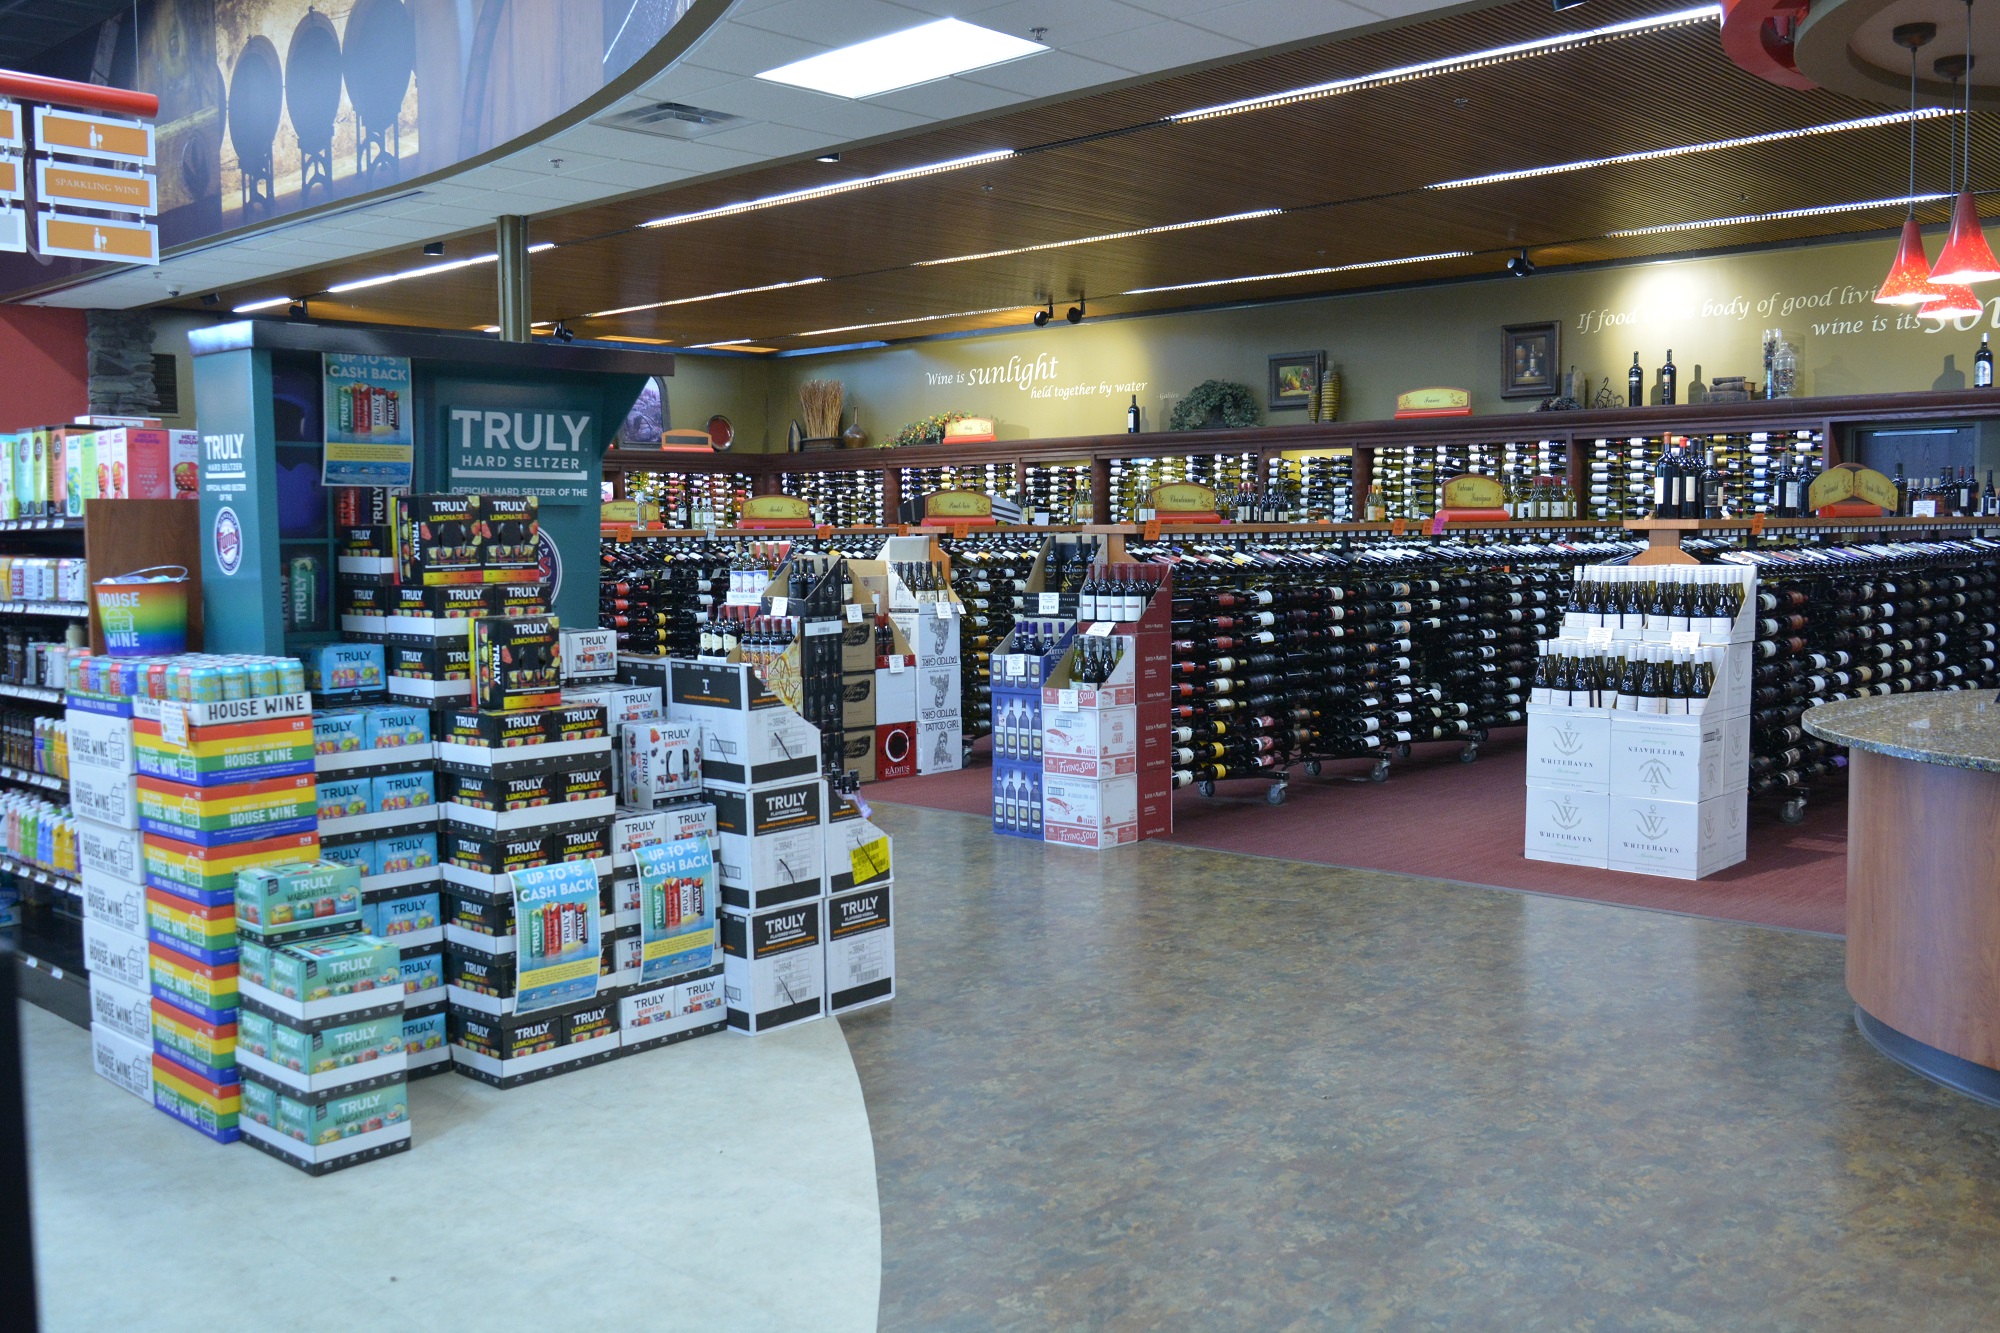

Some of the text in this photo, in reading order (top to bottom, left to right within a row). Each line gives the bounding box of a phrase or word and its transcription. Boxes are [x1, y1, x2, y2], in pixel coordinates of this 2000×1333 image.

[55, 178, 141, 196] SPARKLING WINE
[1577, 310, 1596, 335] If
[1593, 306, 1639, 333] food
[1701, 295, 1750, 320] body
[1757, 292, 1781, 318] of
[1781, 287, 1838, 317] good
[1811, 317, 1863, 336] wine
[1872, 314, 1888, 332] is
[1896, 313, 1922, 330] its
[329, 365, 406, 381] CASH BACK
[925, 352, 1059, 391] Wine is sunlight
[1031, 380, 1148, 401] held together by water
[341, 396, 349, 427] TRULY
[452, 409, 590, 452] TRULY
[203, 433, 244, 461] TRULY
[208, 462, 243, 472] HARD SELTZER
[462, 455, 580, 469] HARD SELTZER
[451, 486, 588, 497] OFFICIAL HARD SELTZER OF THE
[432, 501, 468, 512] TRULY
[493, 501, 527, 512] TRULY
[429, 513, 465, 522] LEMONADE
[490, 513, 524, 522] LEMONADE
[351, 530, 371, 540] TRULY
[413, 521, 421, 561] TRULY
[295, 574, 307, 623] TRULY
[401, 590, 423, 600] TRULY
[447, 589, 483, 600] TRULY
[507, 586, 540, 598] TRULY
[98, 591, 141, 608] HOUSE
[445, 600, 479, 609] LEMONADE
[504, 597, 537, 606] LEMONADE
[514, 623, 549, 635] TRULY
[107, 632, 140, 648] WINE
[511, 636, 545, 645] LEMONADE
[579, 635, 608, 646] TRULY
[336, 650, 371, 662] TRULY
[401, 650, 423, 662] TRULY
[922, 656, 958, 666] TATTOO GIRL
[623, 692, 652, 704] TRULY
[1078, 691, 1095, 704] SOLO
[208, 695, 305, 720] HOUSE WINE
[627, 703, 642, 712] BERRY
[922, 708, 958, 719] TATTOO GIRL
[380, 715, 416, 729] TRULY
[455, 715, 479, 728] TRULY
[505, 715, 541, 728] TRULY
[564, 709, 599, 722] TRULY
[314, 721, 352, 734] TRULY
[561, 719, 594, 731] LEMONADE
[925, 720, 960, 732] TATTOO GIRL
[661, 728, 691, 740] TRULY
[72, 735, 109, 758] HOUSE WINE
[664, 740, 681, 748] BERRY
[224, 748, 293, 768] HOUSE WINE
[1628, 746, 1685, 757] WHITEHAVEN
[1058, 760, 1096, 773] FLYING SOLO
[1540, 757, 1593, 768] WHITEHAVEN
[569, 770, 601, 783] TRULY
[885, 765, 910, 775] RADIUS
[387, 776, 423, 790] TRULY
[508, 778, 544, 792] TRULY
[76, 787, 110, 811] HOUSE WINE
[766, 791, 808, 811] TRULY
[229, 804, 298, 827] HOUSE WINE
[625, 820, 655, 833] TRULY
[1060, 828, 1097, 843] FLYING SOLO
[1539, 831, 1593, 843] WHITEHAVEN
[84, 839, 118, 865] HOUSE WINE
[506, 840, 542, 855] TRULY
[648, 841, 699, 861] UP TO $5
[1622, 841, 1680, 854] WHITEHAVEN
[643, 854, 710, 879] CASH BACK
[526, 865, 583, 885] UP TO $5
[290, 875, 334, 891] TRULY
[287, 888, 327, 902] MARGARITA
[520, 878, 595, 903] CASH BACK
[392, 900, 427, 915] TRULY
[841, 896, 878, 916] TRULY
[765, 912, 806, 934] TRULY
[532, 920, 541, 953] TRULY
[330, 956, 373, 974] TRULY
[686, 981, 716, 997] TRULY
[634, 993, 665, 1009] TRULY
[689, 993, 707, 1004] BERRY
[515, 1023, 550, 1040] TRULY
[338, 1094, 381, 1115] TRULY
